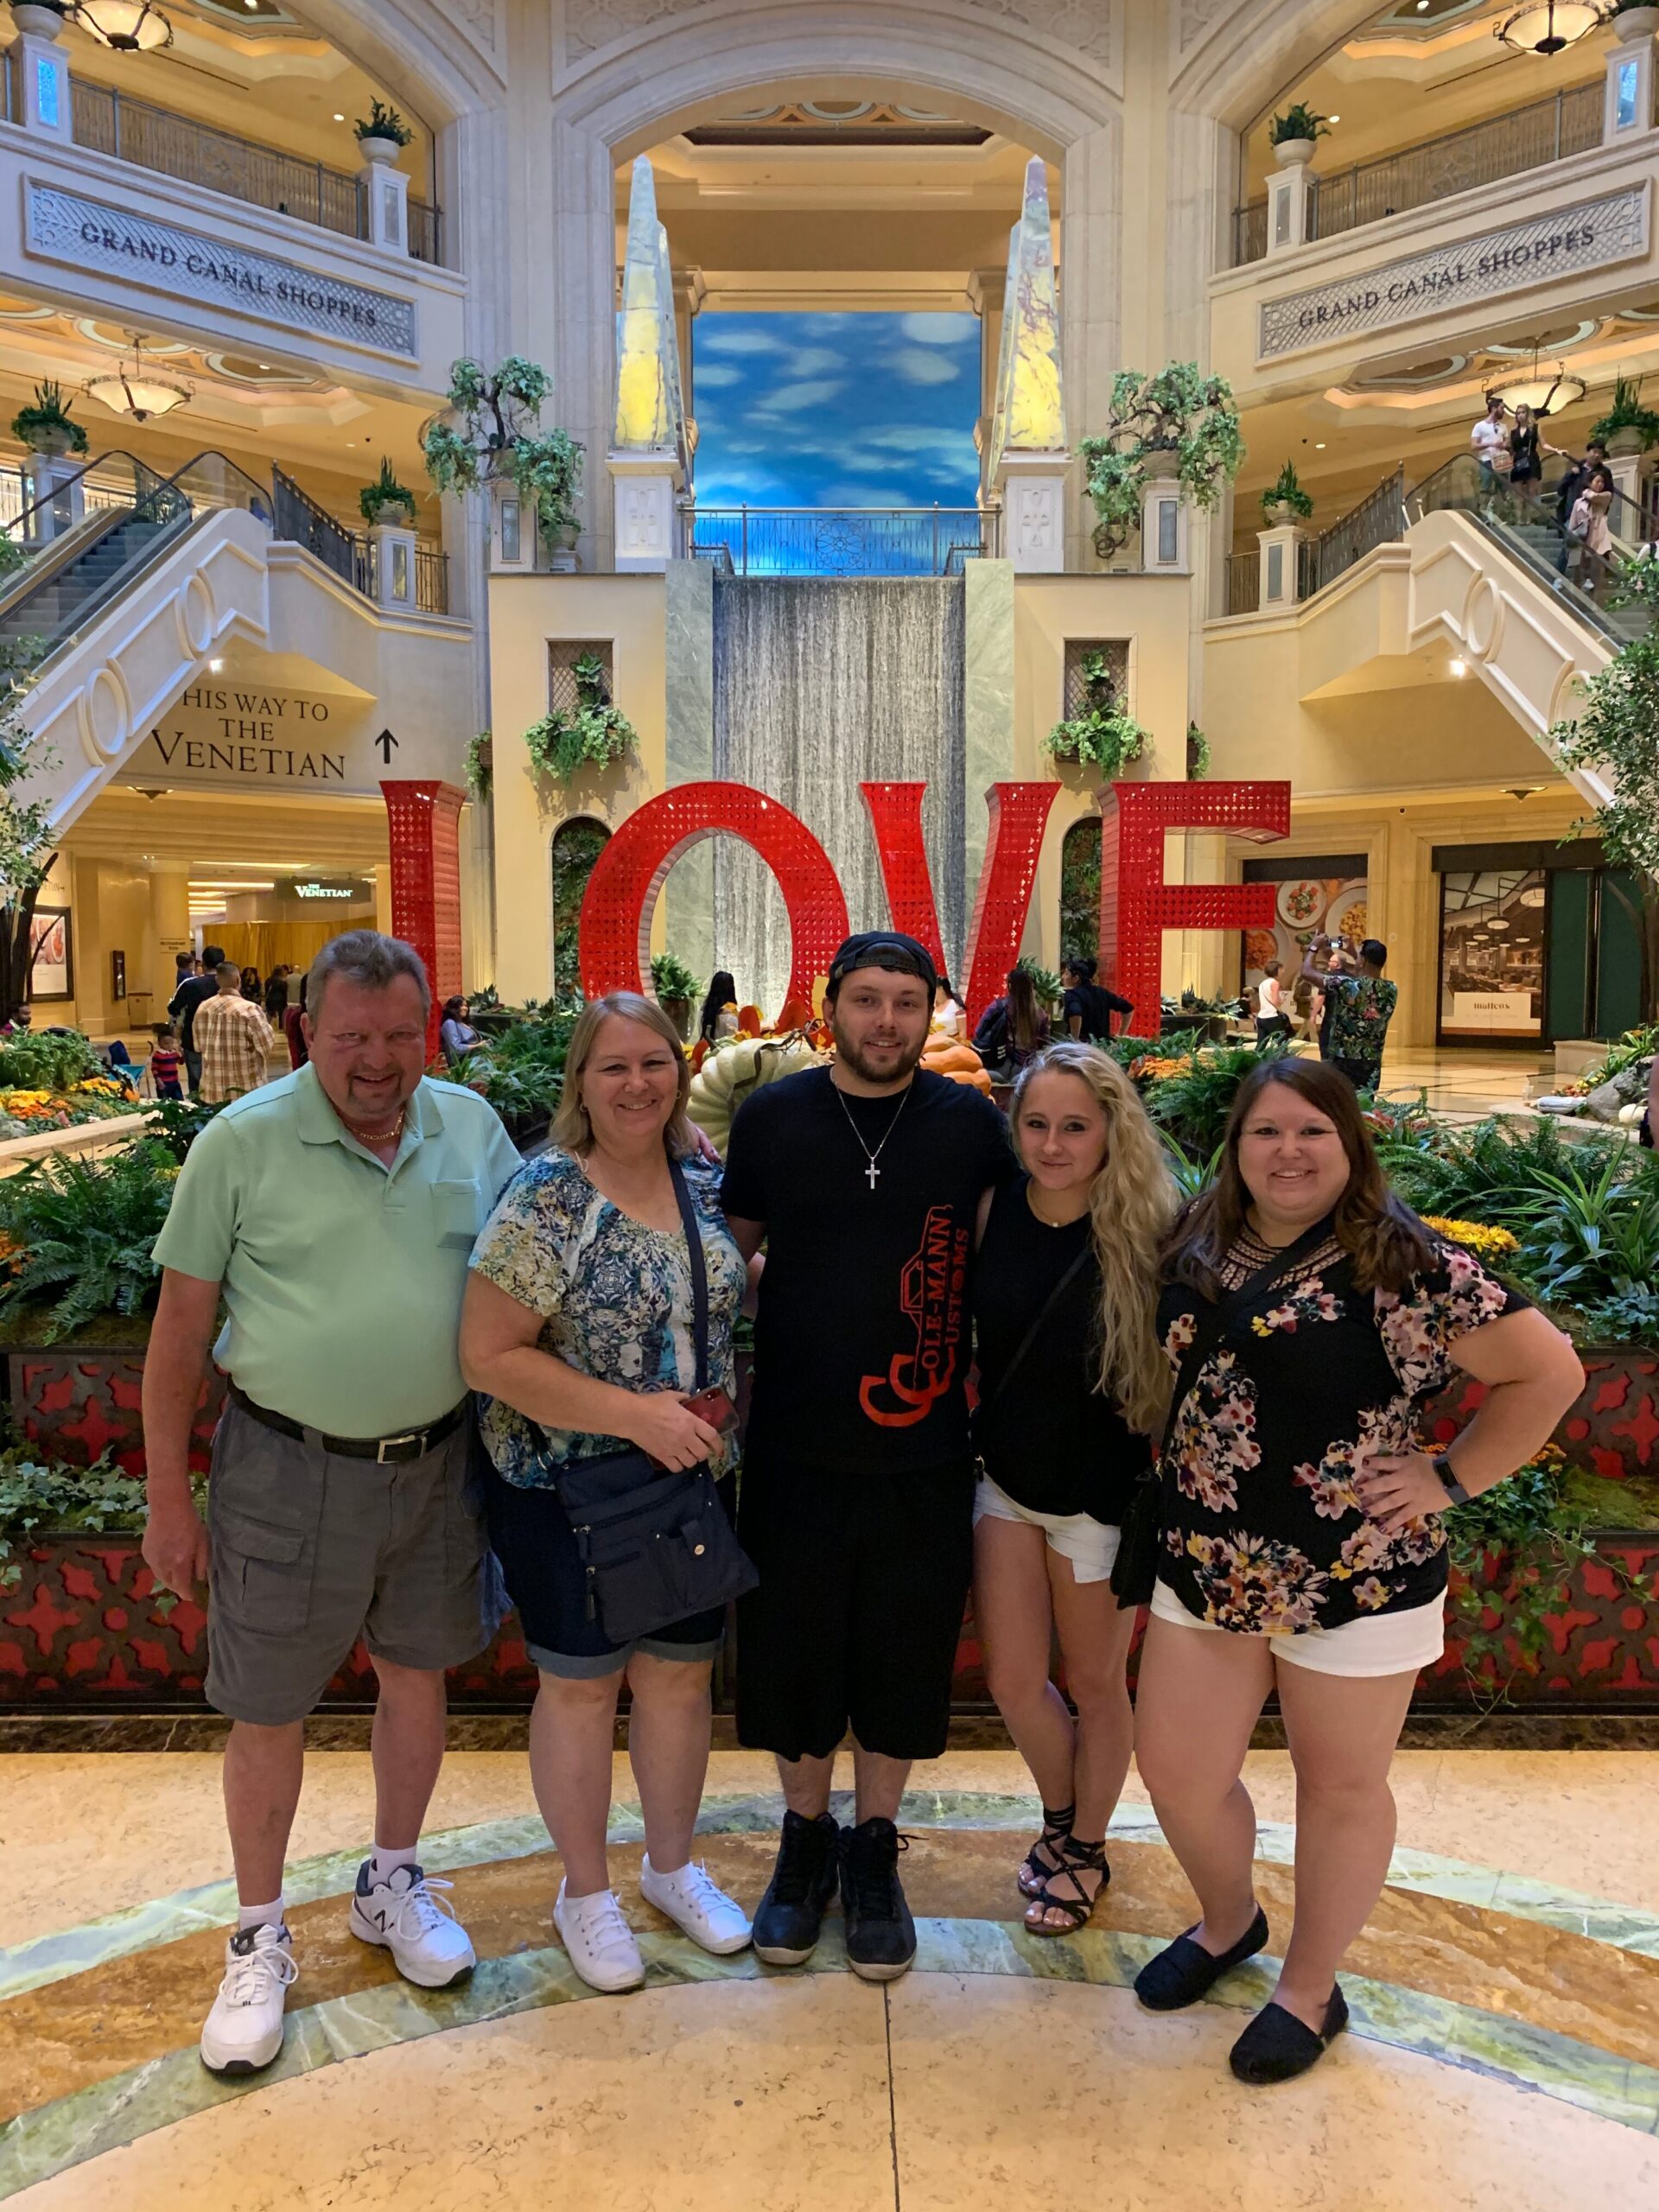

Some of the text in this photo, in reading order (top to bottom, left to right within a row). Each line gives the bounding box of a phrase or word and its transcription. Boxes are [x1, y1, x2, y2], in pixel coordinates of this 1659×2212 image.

[80, 222, 377, 327] GRAND CANAL SHOPPES
[1299, 225, 1595, 328] GRAND CANAL SHOPPES
[182, 688, 329, 722] HIS WAY TO
[219, 718, 275, 741] THE
[151, 728, 346, 780] VENETIAN
[295, 885, 350, 898] VENETIAN
